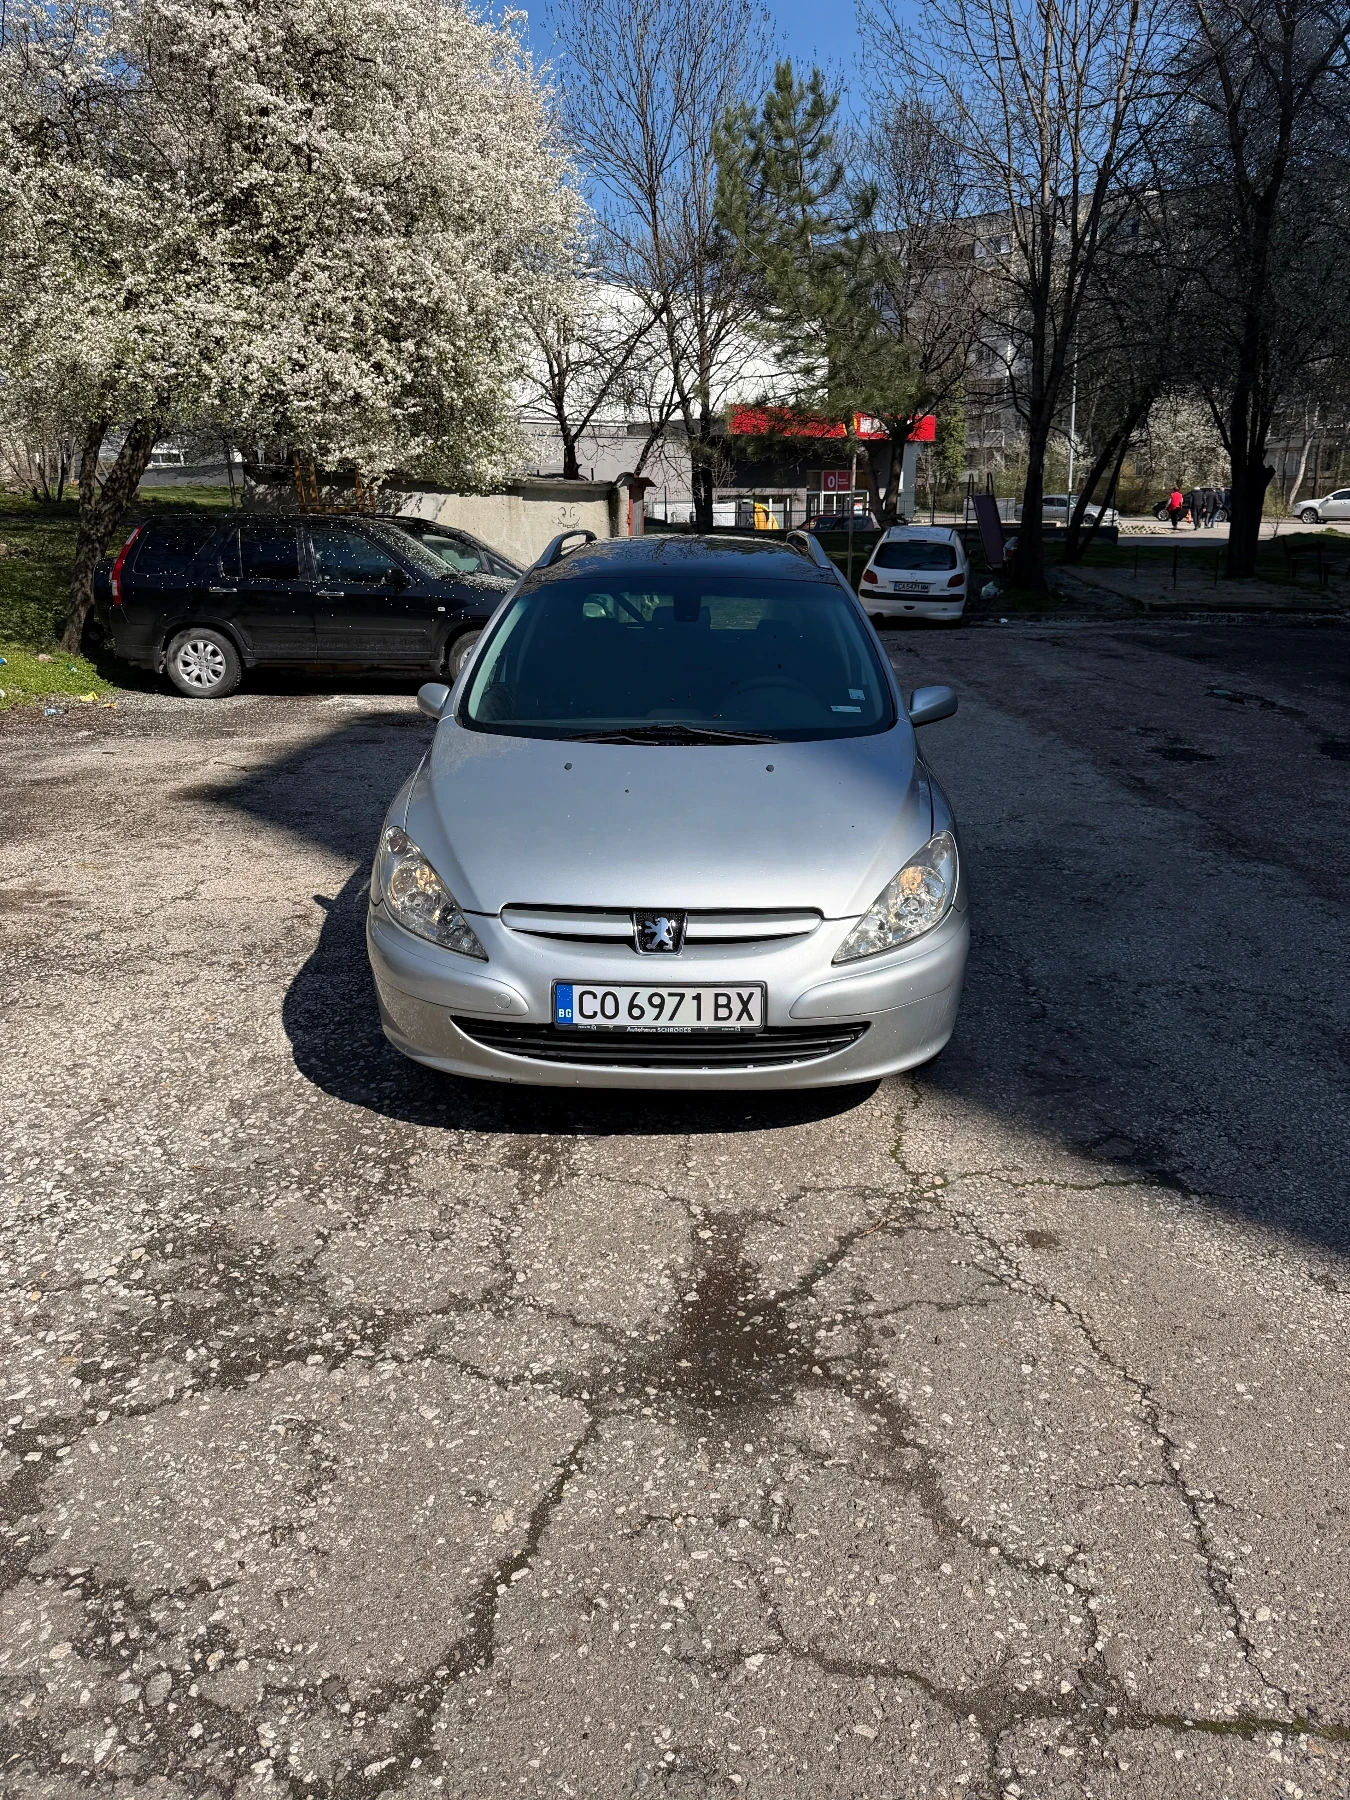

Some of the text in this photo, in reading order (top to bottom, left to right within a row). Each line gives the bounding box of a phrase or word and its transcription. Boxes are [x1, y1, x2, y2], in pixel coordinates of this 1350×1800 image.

[558, 1008, 572, 1018] BG
[578, 990, 755, 1022] CO 6971 BX
